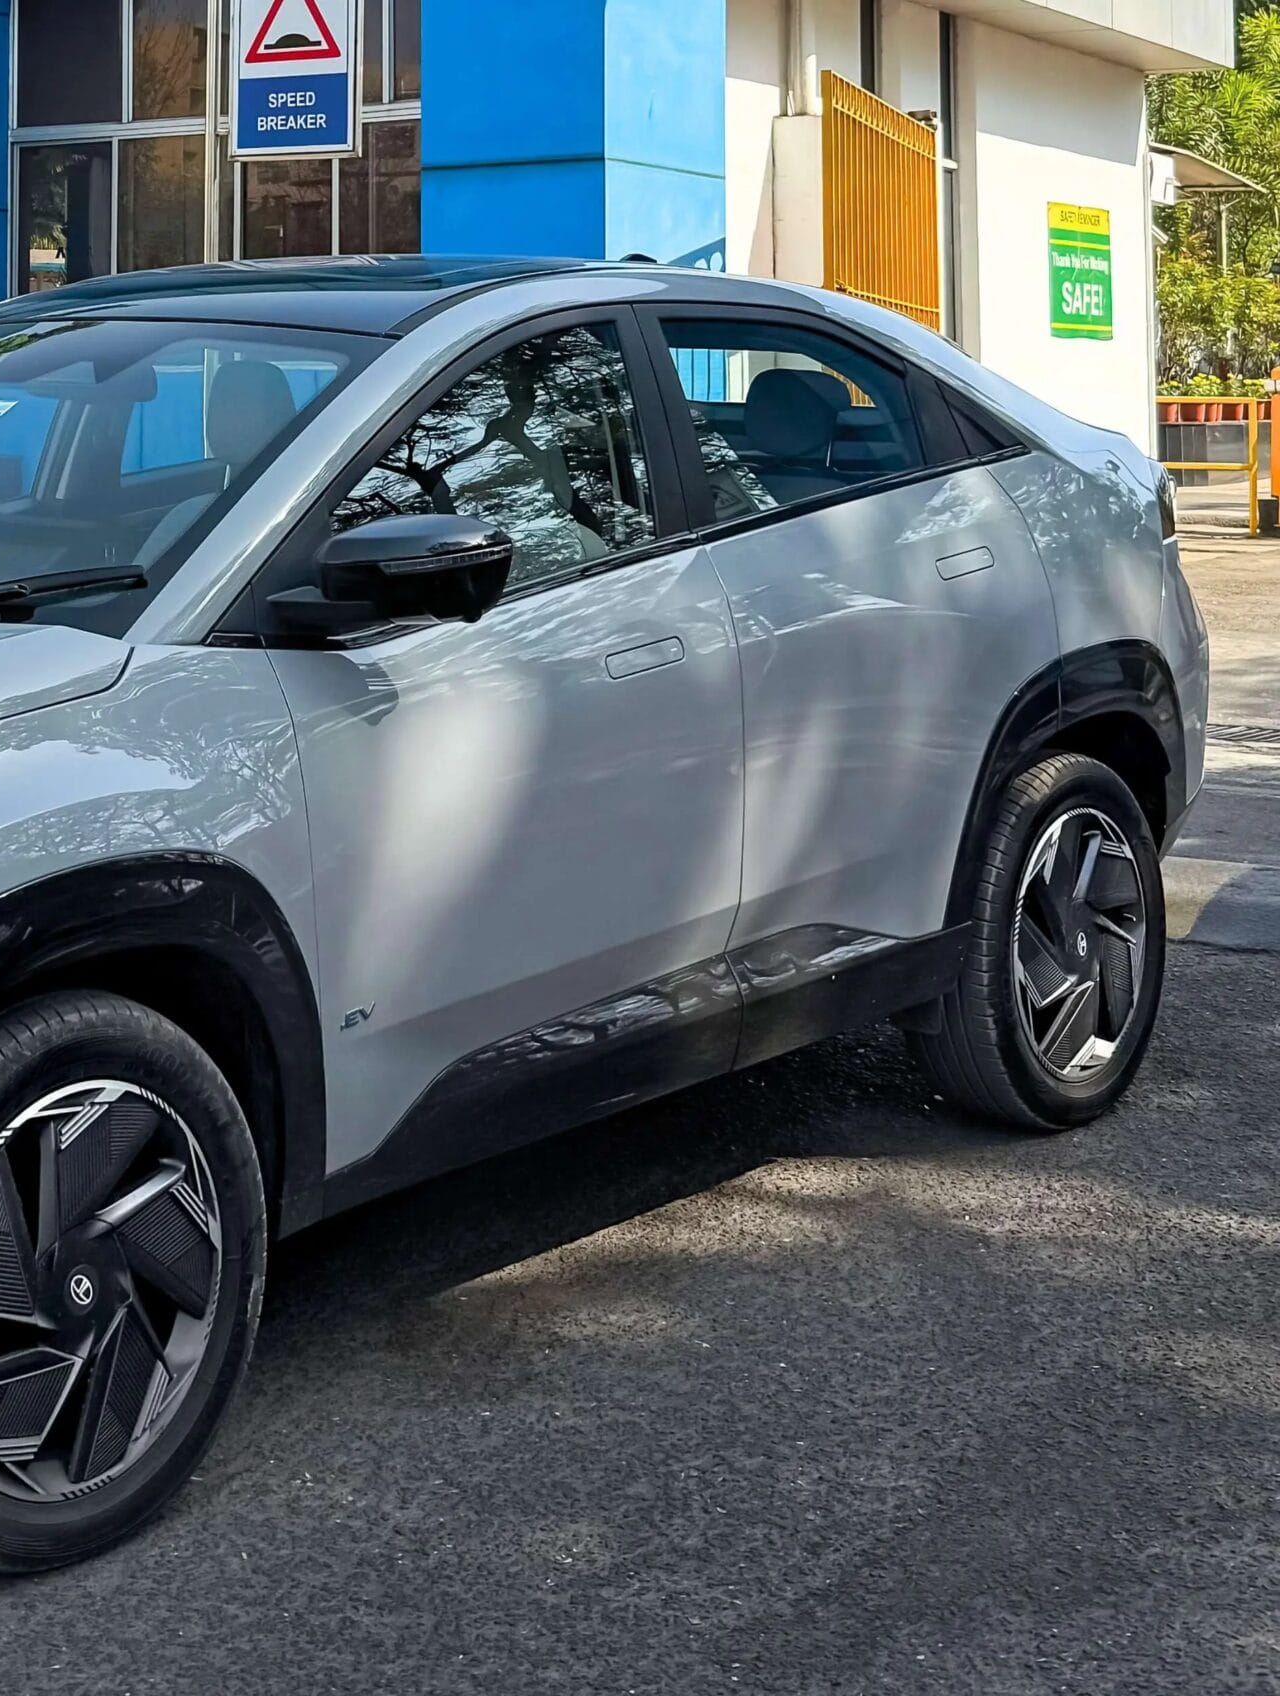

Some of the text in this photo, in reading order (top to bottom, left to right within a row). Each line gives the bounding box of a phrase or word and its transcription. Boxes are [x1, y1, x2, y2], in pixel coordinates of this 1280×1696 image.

[268, 92, 316, 108] SPEED
[257, 113, 327, 131] BREAKER
[1052, 251, 1071, 268] Thank
[1062, 281, 1104, 316] SAFE!
